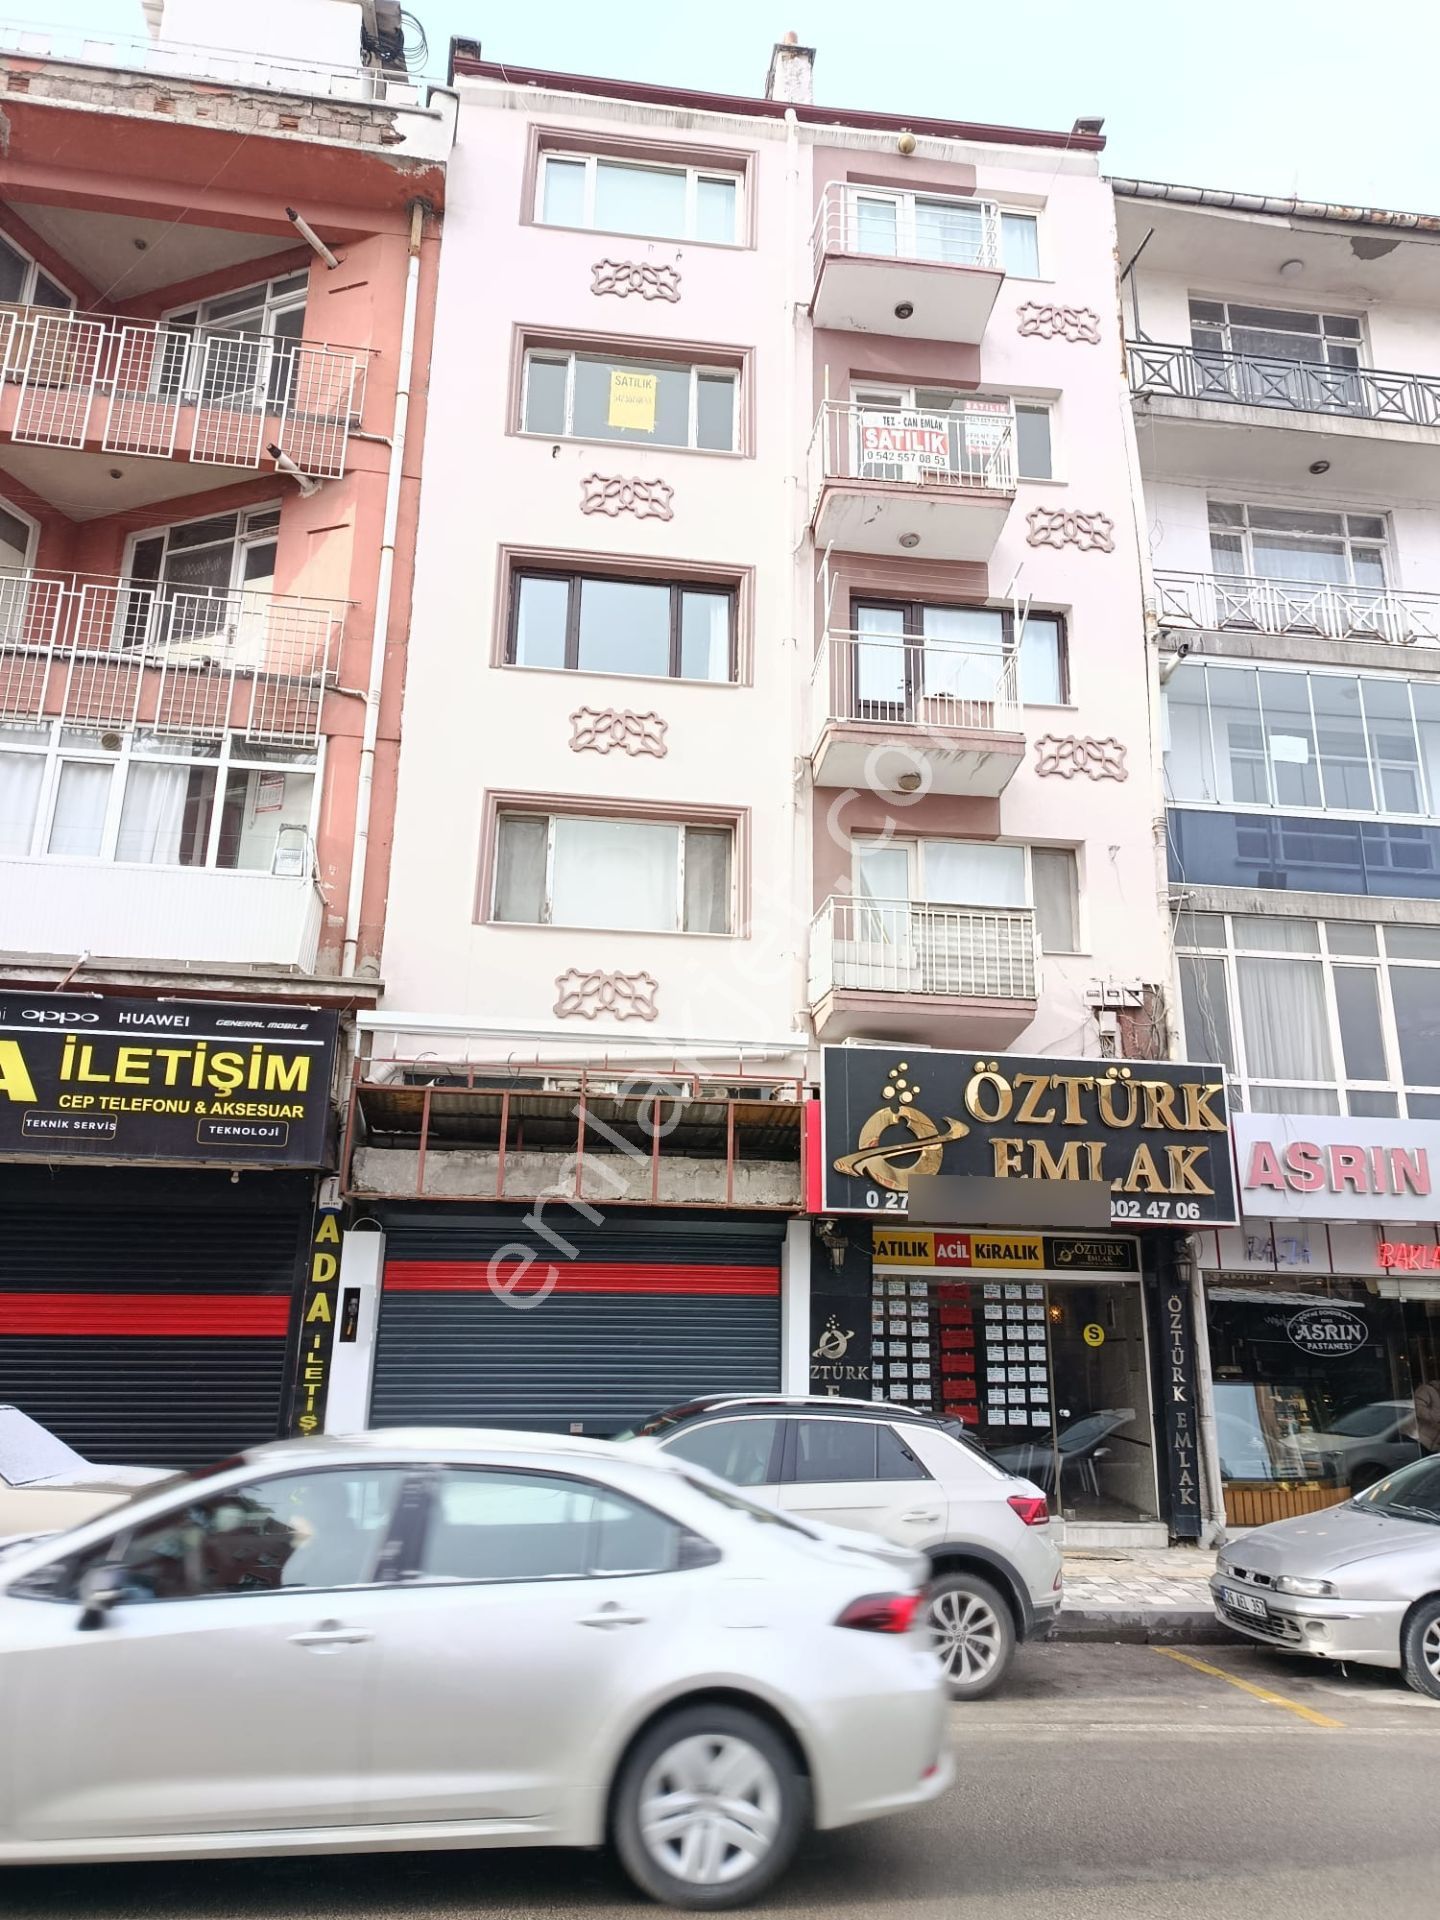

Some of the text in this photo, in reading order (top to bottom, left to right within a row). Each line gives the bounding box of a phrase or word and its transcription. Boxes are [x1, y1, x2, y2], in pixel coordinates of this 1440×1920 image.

[614, 375, 652, 389] SATILIK
[882, 415, 896, 426] TEZ
[903, 417, 918, 428] CAN
[920, 418, 943, 431] EMLAK
[865, 428, 946, 455] SATILIK
[867, 450, 946, 466] 0 542 557 08 53
[118, 1012, 190, 1028] HUAWEI
[215, 1019, 309, 1031] GENERAL MOBILE
[59, 1034, 311, 1098] İLETİŞİM
[59, 1094, 304, 1119] CEP TELEFONU & AKSESUAR
[964, 1060, 1229, 1133] ÖZTÜRK
[25, 1118, 117, 1131] TEKNİK SERVİS
[208, 1125, 279, 1137] TEKNOLOJİ
[988, 1138, 1216, 1195] EMLAK
[1243, 1140, 1432, 1195] ASRIN
[866, 1190, 878, 1208] 0
[1146, 1201, 1171, 1218] 47
[1175, 1202, 1200, 1220] 06
[937, 1240, 970, 1259] ACİL
[305, 1214, 340, 1323] ADA
[1294, 1324, 1362, 1341] ASRIN
[1167, 1294, 1188, 1402] ÖZTÜRK
[1174, 1412, 1196, 1505] EMLAK
